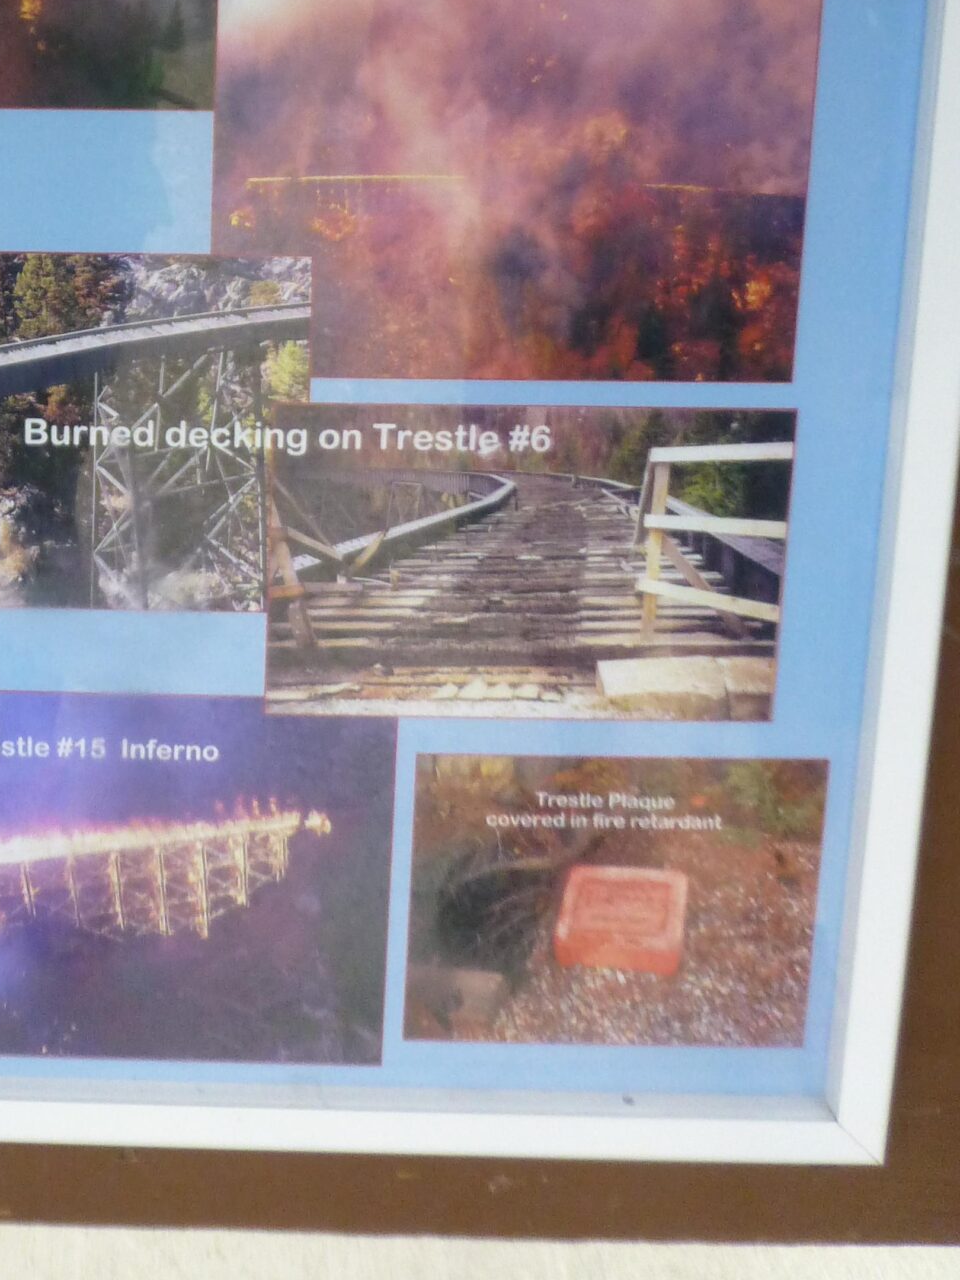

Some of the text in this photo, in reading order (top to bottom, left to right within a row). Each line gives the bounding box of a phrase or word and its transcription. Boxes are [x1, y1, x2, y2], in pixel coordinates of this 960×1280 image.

[24, 417, 552, 456] Burned decking on Trestle #6
[56, 736, 107, 760] #15
[121, 738, 220, 763] Inferno
[535, 791, 676, 811] Trestle Plaque
[485, 812, 723, 831] covered in fire retardant
